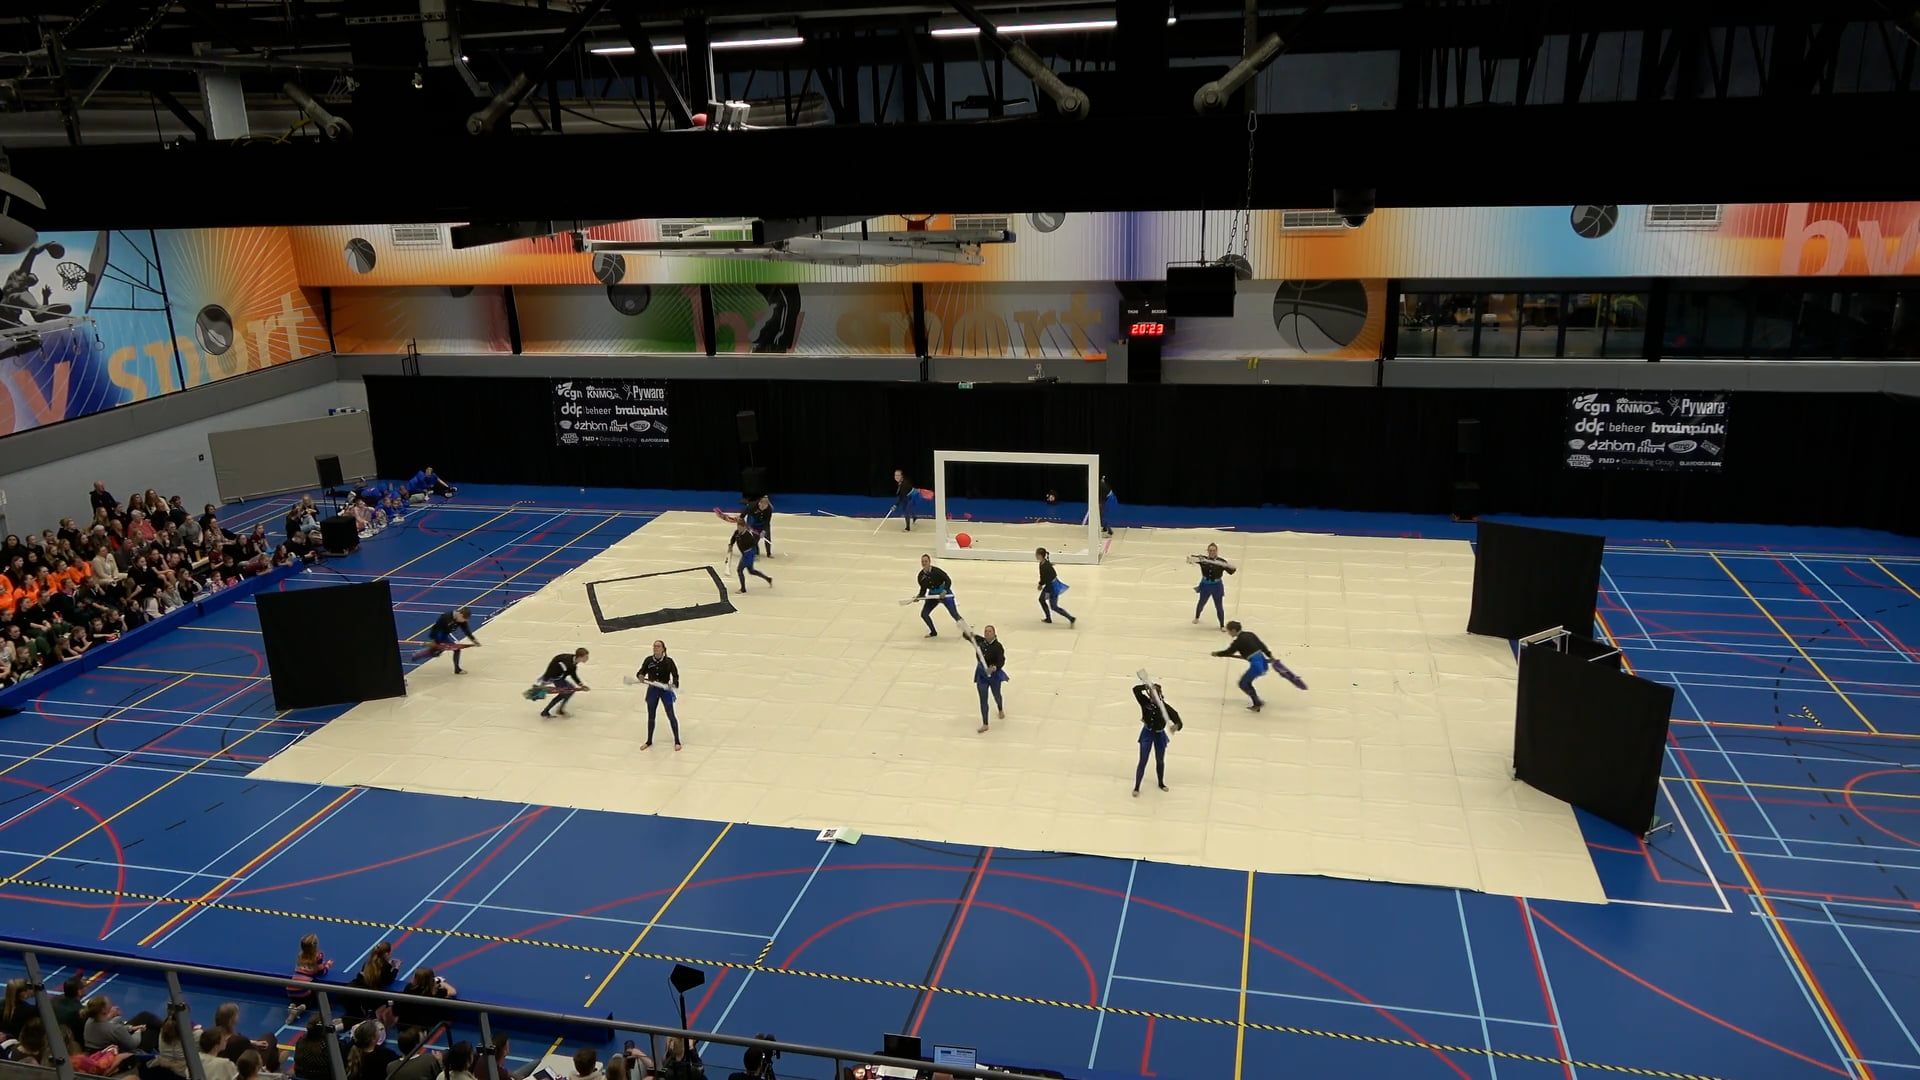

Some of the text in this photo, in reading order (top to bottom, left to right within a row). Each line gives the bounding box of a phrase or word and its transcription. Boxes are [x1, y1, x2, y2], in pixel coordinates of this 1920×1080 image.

[1131, 323, 1164, 334] 20:23
[565, 389, 583, 400] cgn
[632, 385, 664, 400] Pyware
[561, 402, 668, 417] ddf beheer brainpink
[1583, 402, 1610, 415] cgn
[1681, 398, 1725, 416] Pyware
[1575, 418, 1724, 435] ddf beheer brainpink
